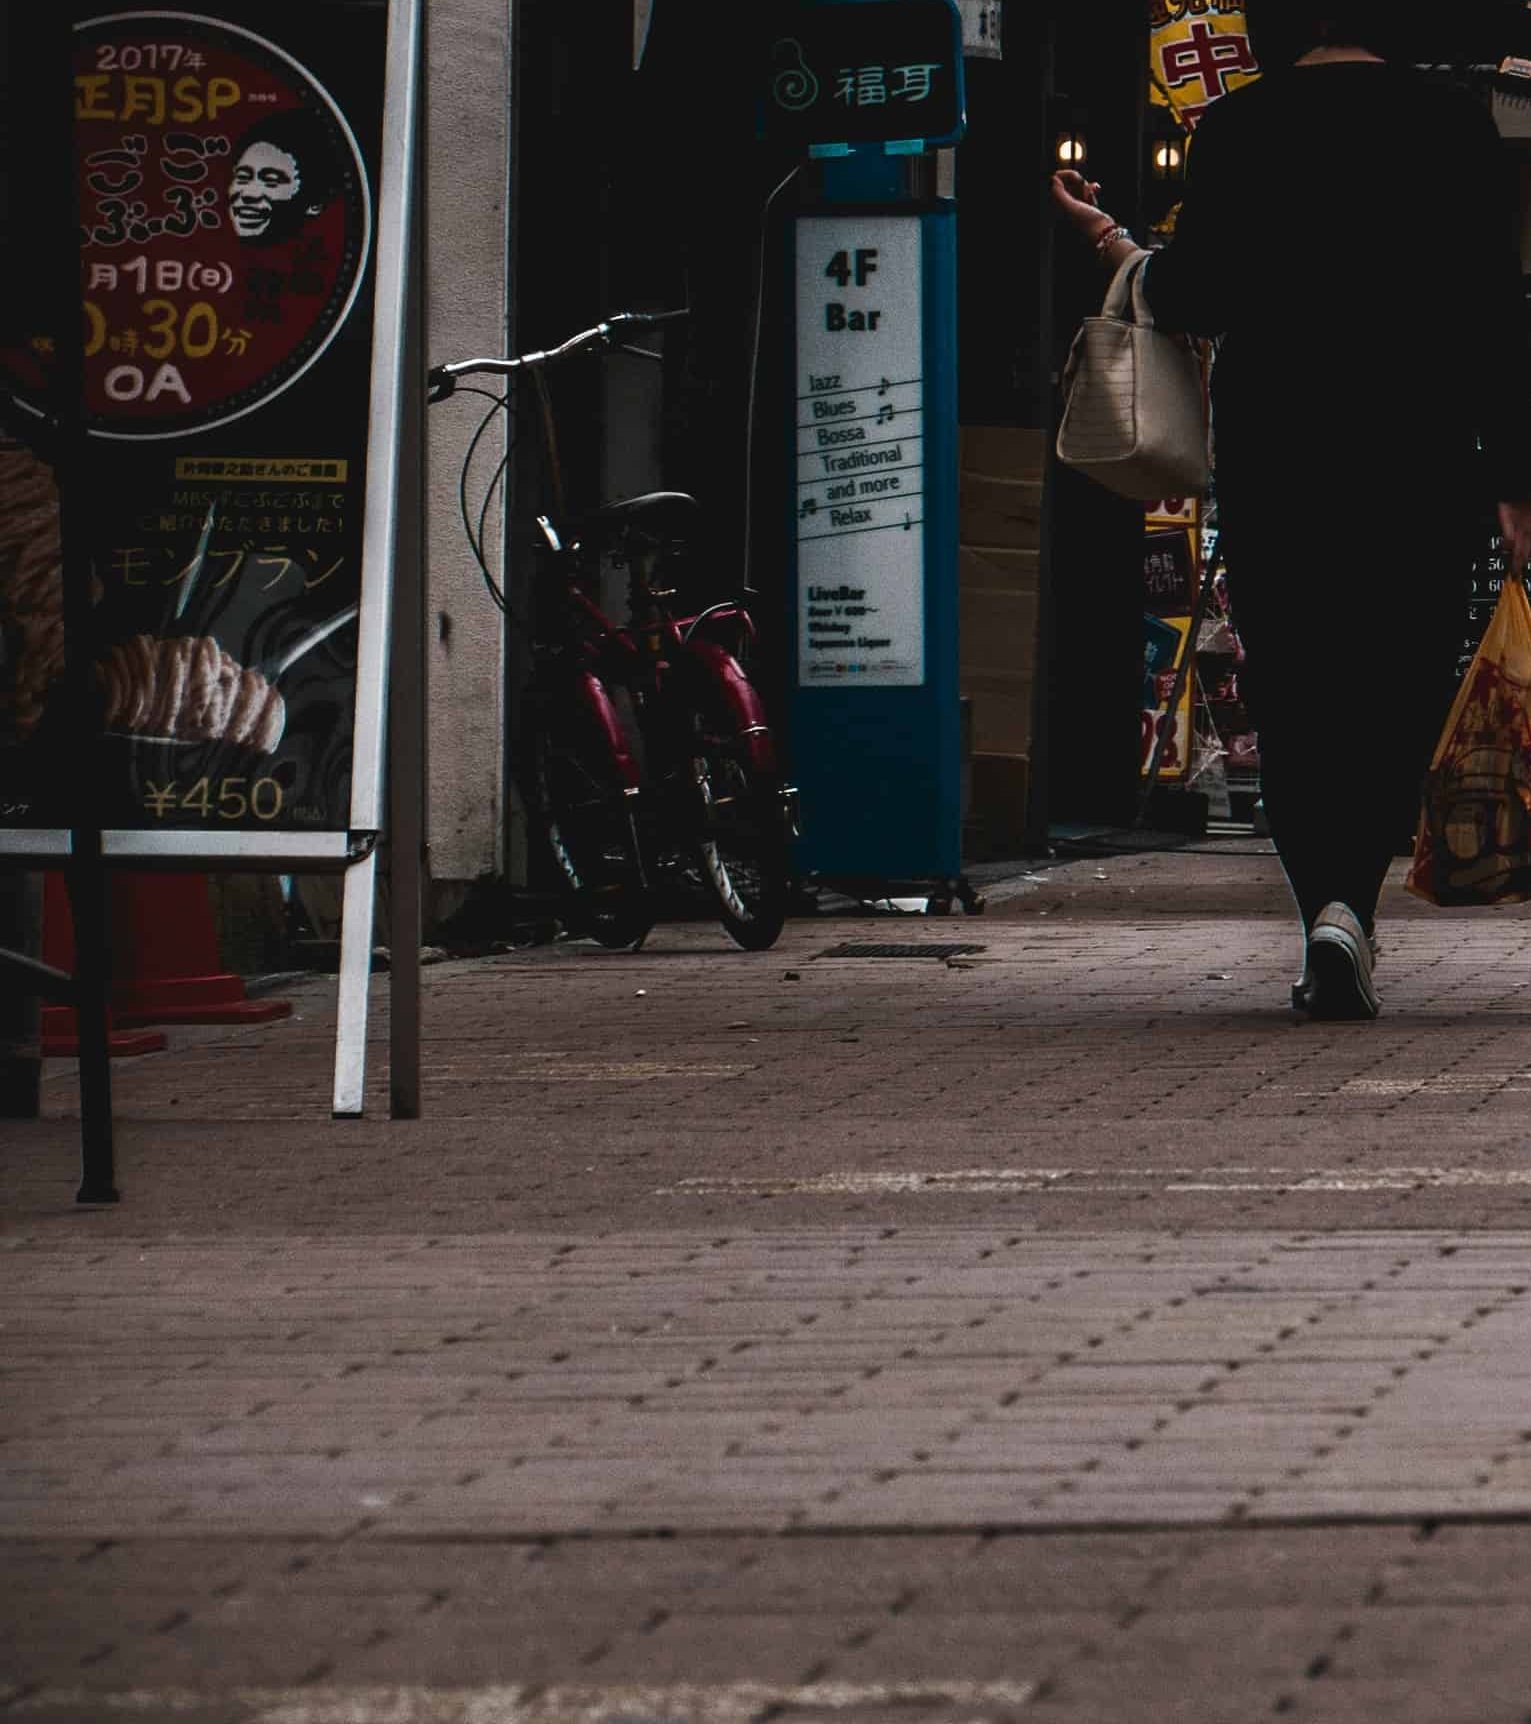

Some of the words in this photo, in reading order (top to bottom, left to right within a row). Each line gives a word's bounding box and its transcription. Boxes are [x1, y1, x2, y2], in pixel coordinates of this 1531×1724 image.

[95, 43, 209, 72] 2017年
[834, 61, 943, 107] 福耳
[86, 254, 234, 296] 月1日(日)
[824, 248, 879, 289] 4F
[825, 302, 881, 333] Bar
[103, 362, 193, 405] OA
[808, 374, 843, 393] Jazz
[812, 399, 857, 420] Blues
[817, 425, 866, 447] Bossa
[822, 444, 903, 474] Traditional
[826, 479, 856, 501] and
[859, 476, 901, 495] more
[829, 507, 873, 528] Relax
[111, 539, 345, 592] モンブラン
[143, 776, 283, 820] ¥450
